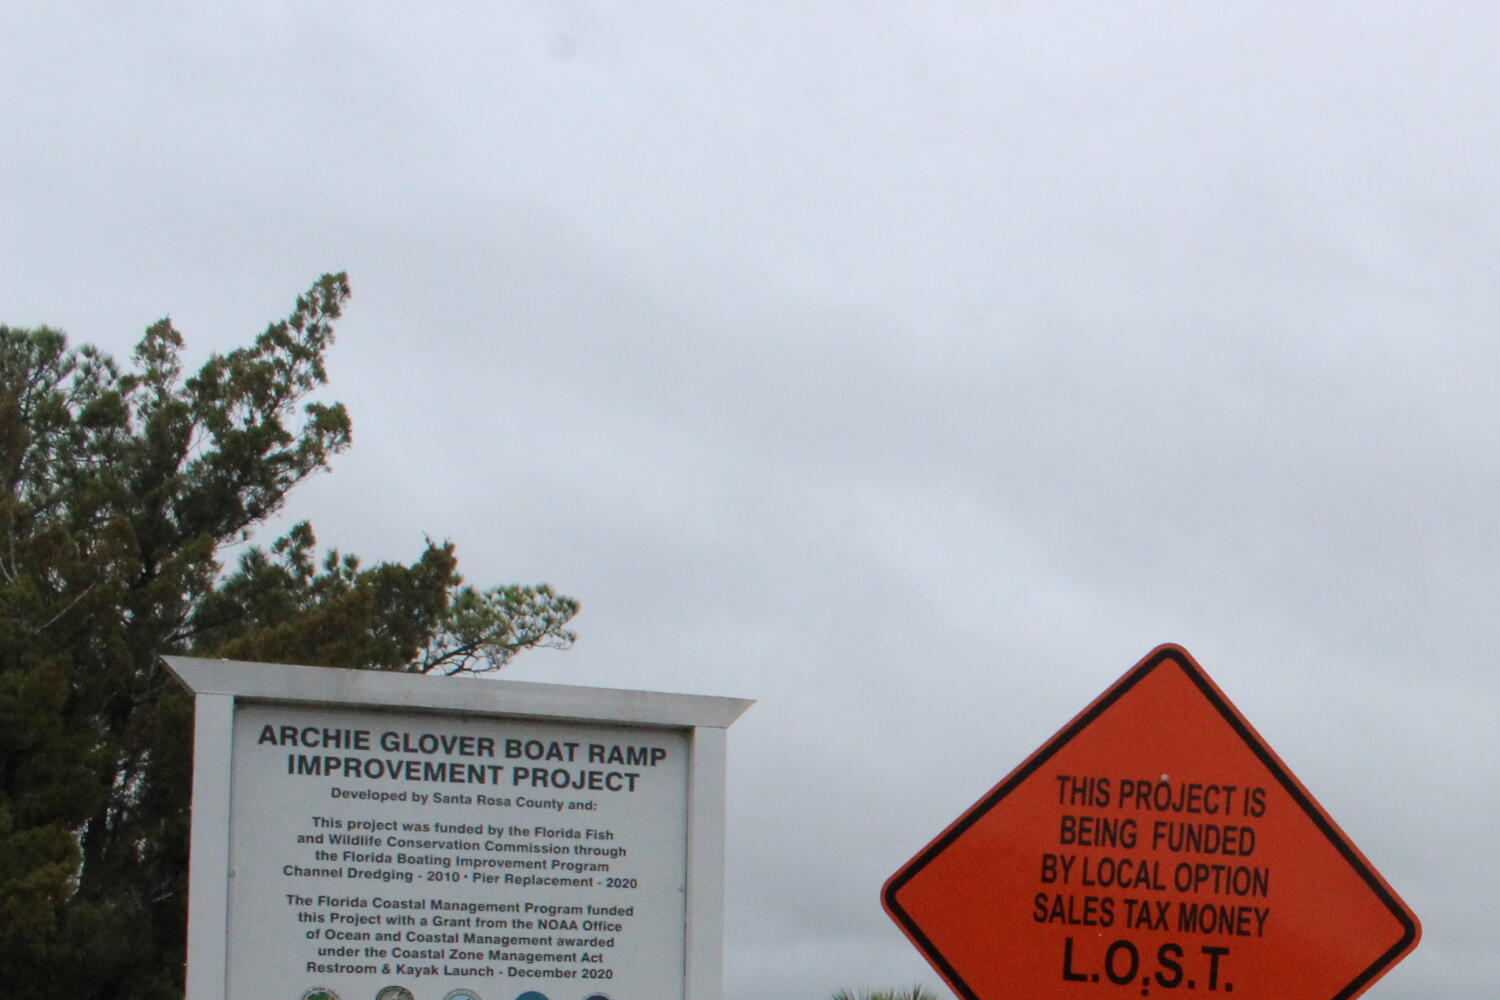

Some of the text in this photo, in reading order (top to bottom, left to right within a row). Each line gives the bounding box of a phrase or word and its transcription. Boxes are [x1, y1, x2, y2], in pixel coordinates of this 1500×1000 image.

[258, 725, 667, 767] ARCHIE GLOVER BOAT RAMP
[288, 755, 640, 792] IMPROVEMENT PROJECT
[331, 788, 597, 811] Developed by Santa Rosa County and:
[1056, 775, 1266, 818] THIS PROJECT IS
[312, 817, 614, 840] This project was funded by the Florida Fish
[1060, 815, 1255, 856] BEING FUNDED
[297, 834, 626, 858] and Wildlife Conservation Commission through
[315, 851, 609, 873] the Florida Boating Improvement Program
[283, 865, 342, 877] Channel
[347, 868, 413, 882] Dredging
[427, 872, 459, 882] 2010
[473, 873, 500, 884] Pier
[504, 874, 593, 887] Replacement
[606, 878, 637, 888] 2020
[1041, 854, 1269, 898] BY LOCAL OPTION
[287, 895, 634, 916] The Florida Coastal Management Program funded
[1033, 893, 1269, 937] SALES TAX MONEY
[298, 912, 325, 923] this
[330, 914, 381, 926] Project
[386, 915, 415, 925] with
[433, 916, 470, 928] Grant
[476, 918, 507, 928] from
[512, 919, 533, 929] the
[538, 920, 578, 930] NOAA
[583, 921, 622, 932] Office
[306, 929, 614, 947] of Ocean and Coastal Management awarded
[318, 947, 603, 963] under the Coastal Zone Management Act
[1063, 937, 1233, 992] L.O.S.T.
[306, 962, 377, 974] Restroom
[382, 964, 391, 974] &
[396, 964, 439, 977] Kayak
[444, 965, 493, 976] Launch
[508, 967, 577, 978] December
[581, 969, 613, 979] 2020
